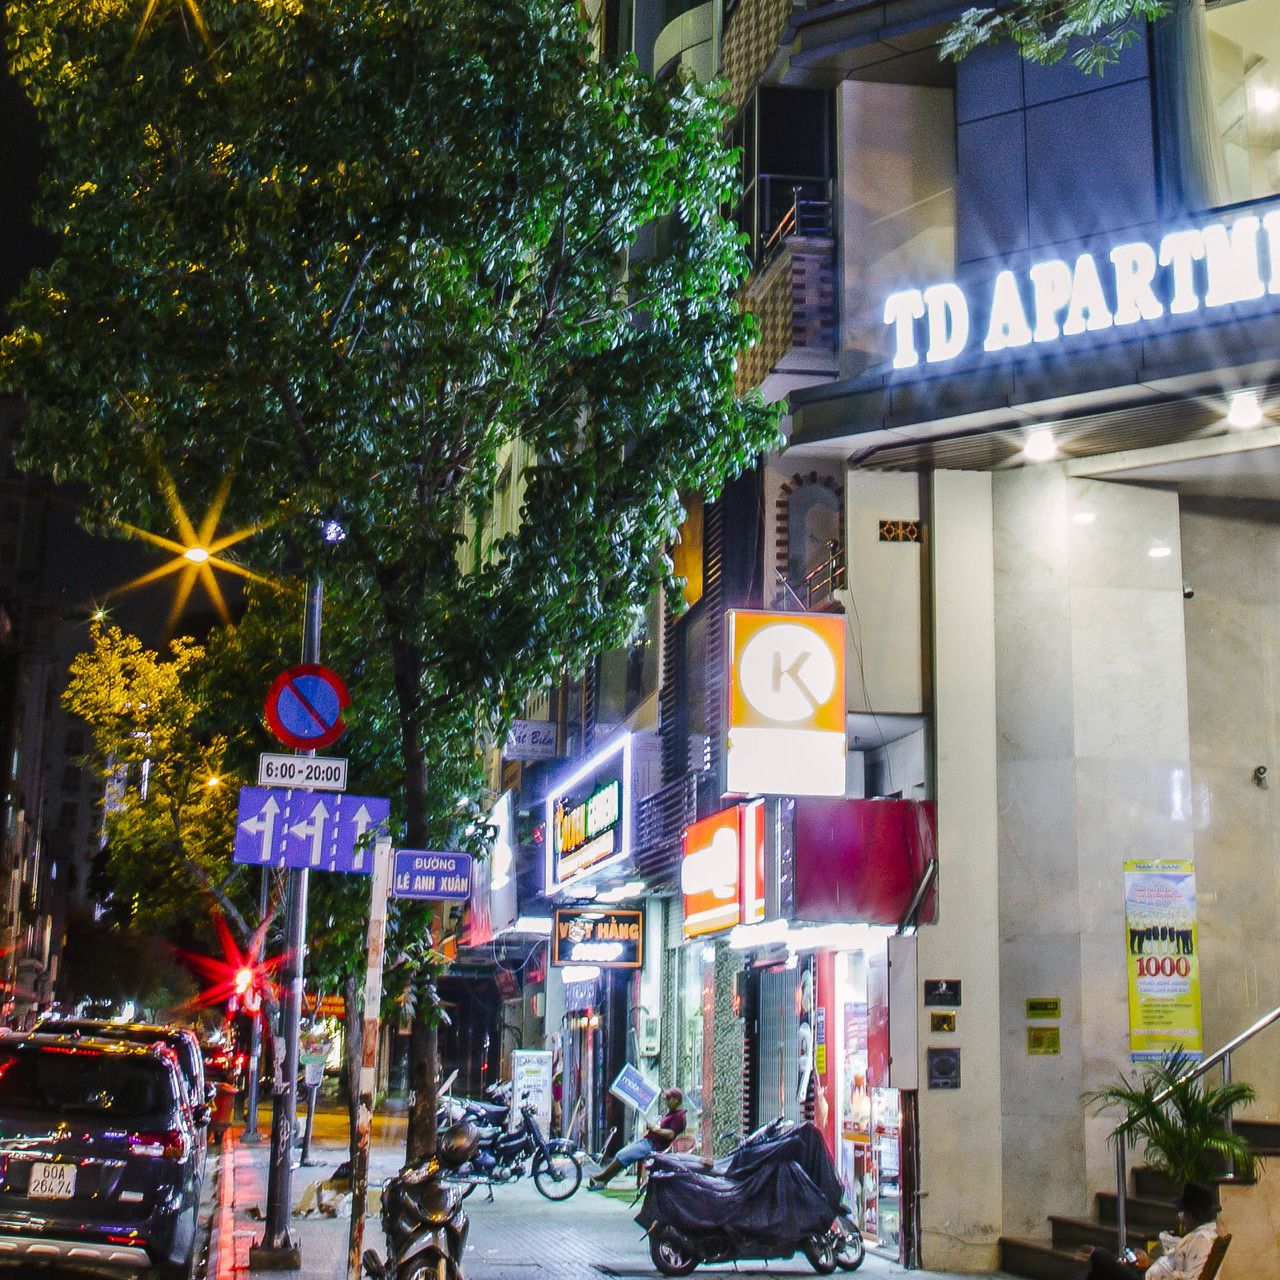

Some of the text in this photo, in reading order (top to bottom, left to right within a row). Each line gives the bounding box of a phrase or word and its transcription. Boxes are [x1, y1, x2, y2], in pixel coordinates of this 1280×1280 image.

[884, 283, 969, 368] TD
[414, 856, 457, 871] ĐƯỜNG
[396, 871, 469, 893] LÊ ANH XUÂN
[1136, 956, 1191, 977] 1000
[43, 1165, 66, 1180] 60A
